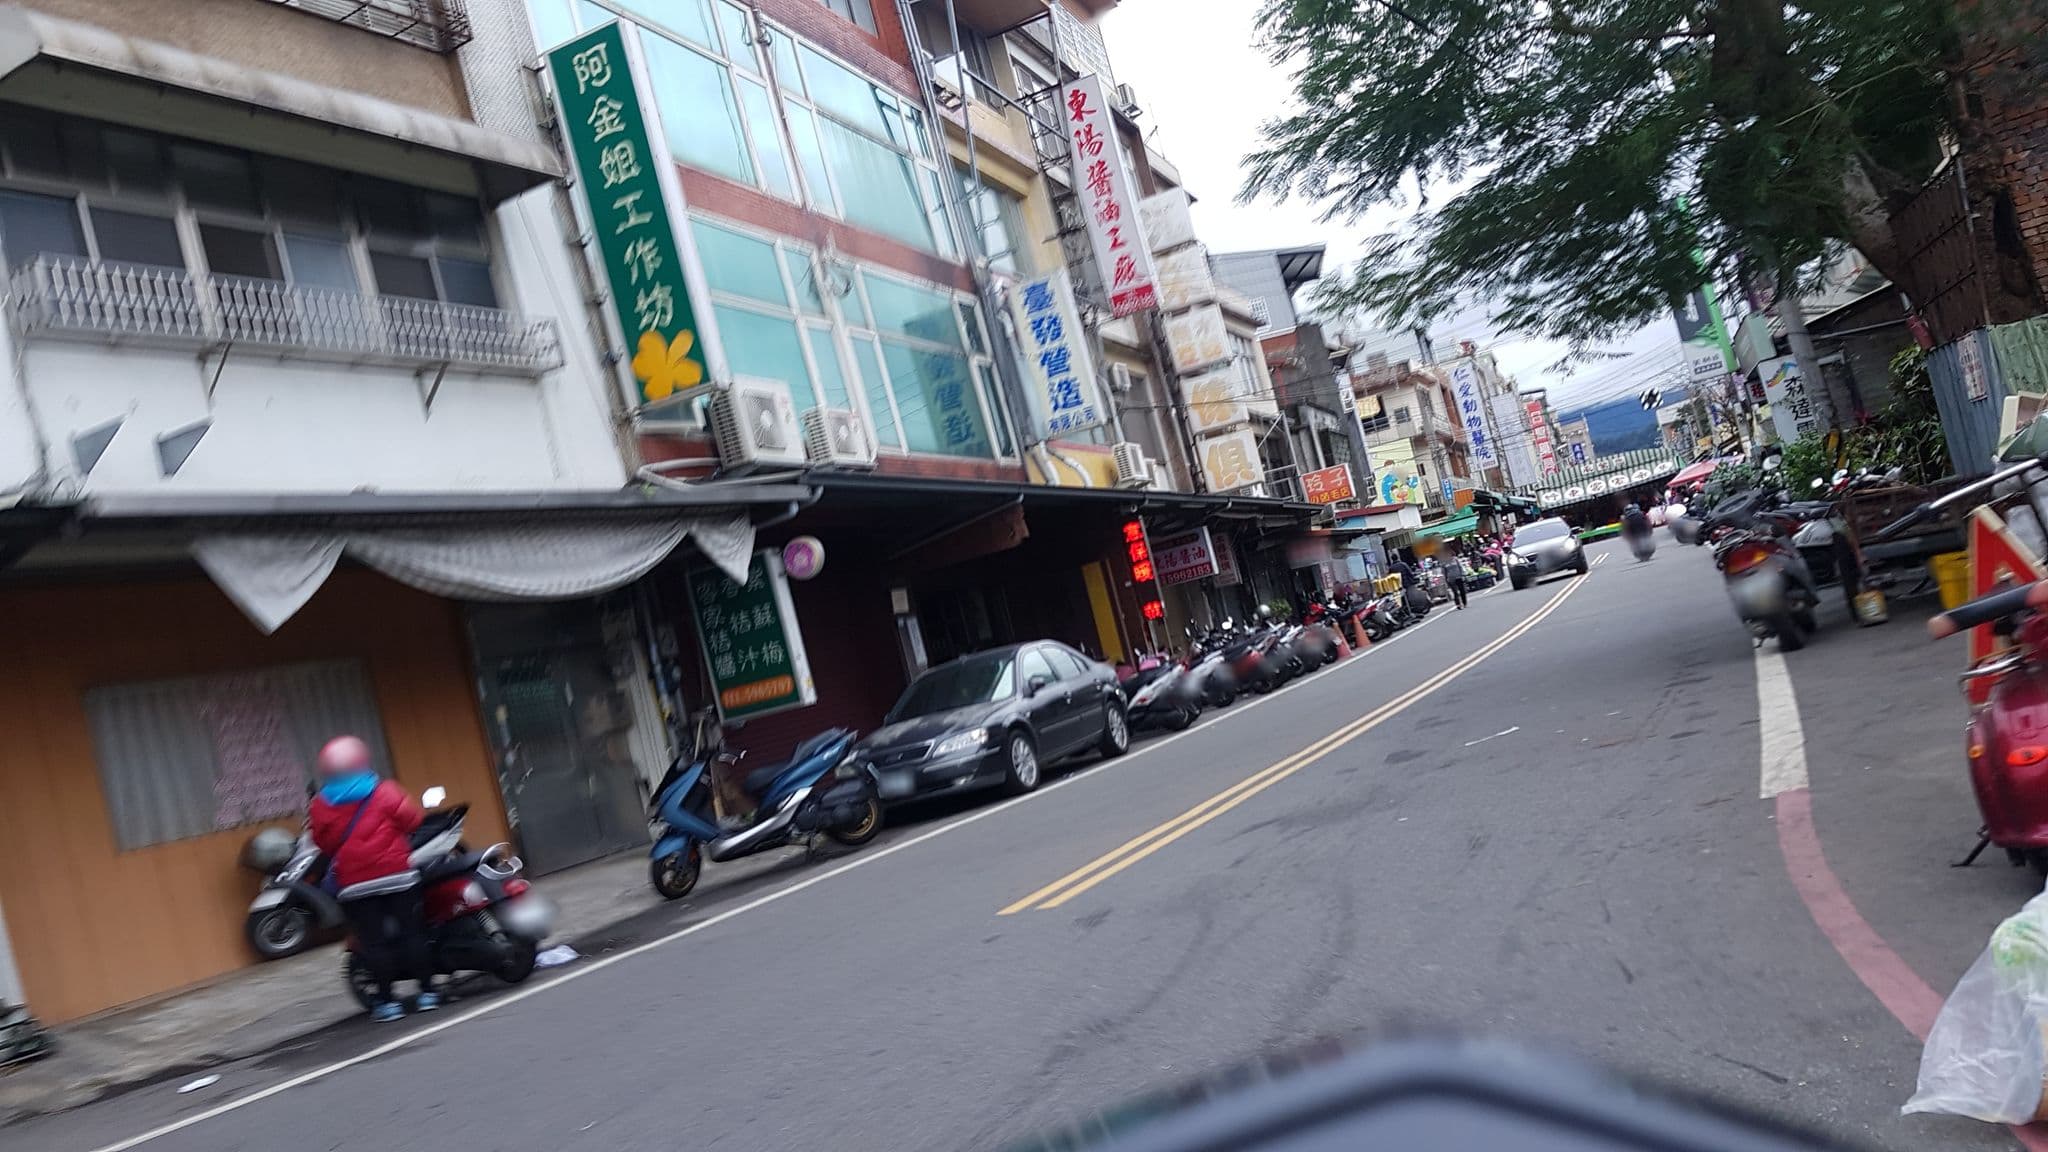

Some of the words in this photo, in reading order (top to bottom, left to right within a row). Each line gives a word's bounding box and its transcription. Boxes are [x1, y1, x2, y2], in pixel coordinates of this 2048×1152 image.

[571, 42, 674, 332] 阿金姐工作坊
[1066, 88, 1146, 289] 東陽醬油工廠
[1306, 467, 1347, 493] 玲子
[1453, 366, 1492, 460] 仁愛動物醫院
